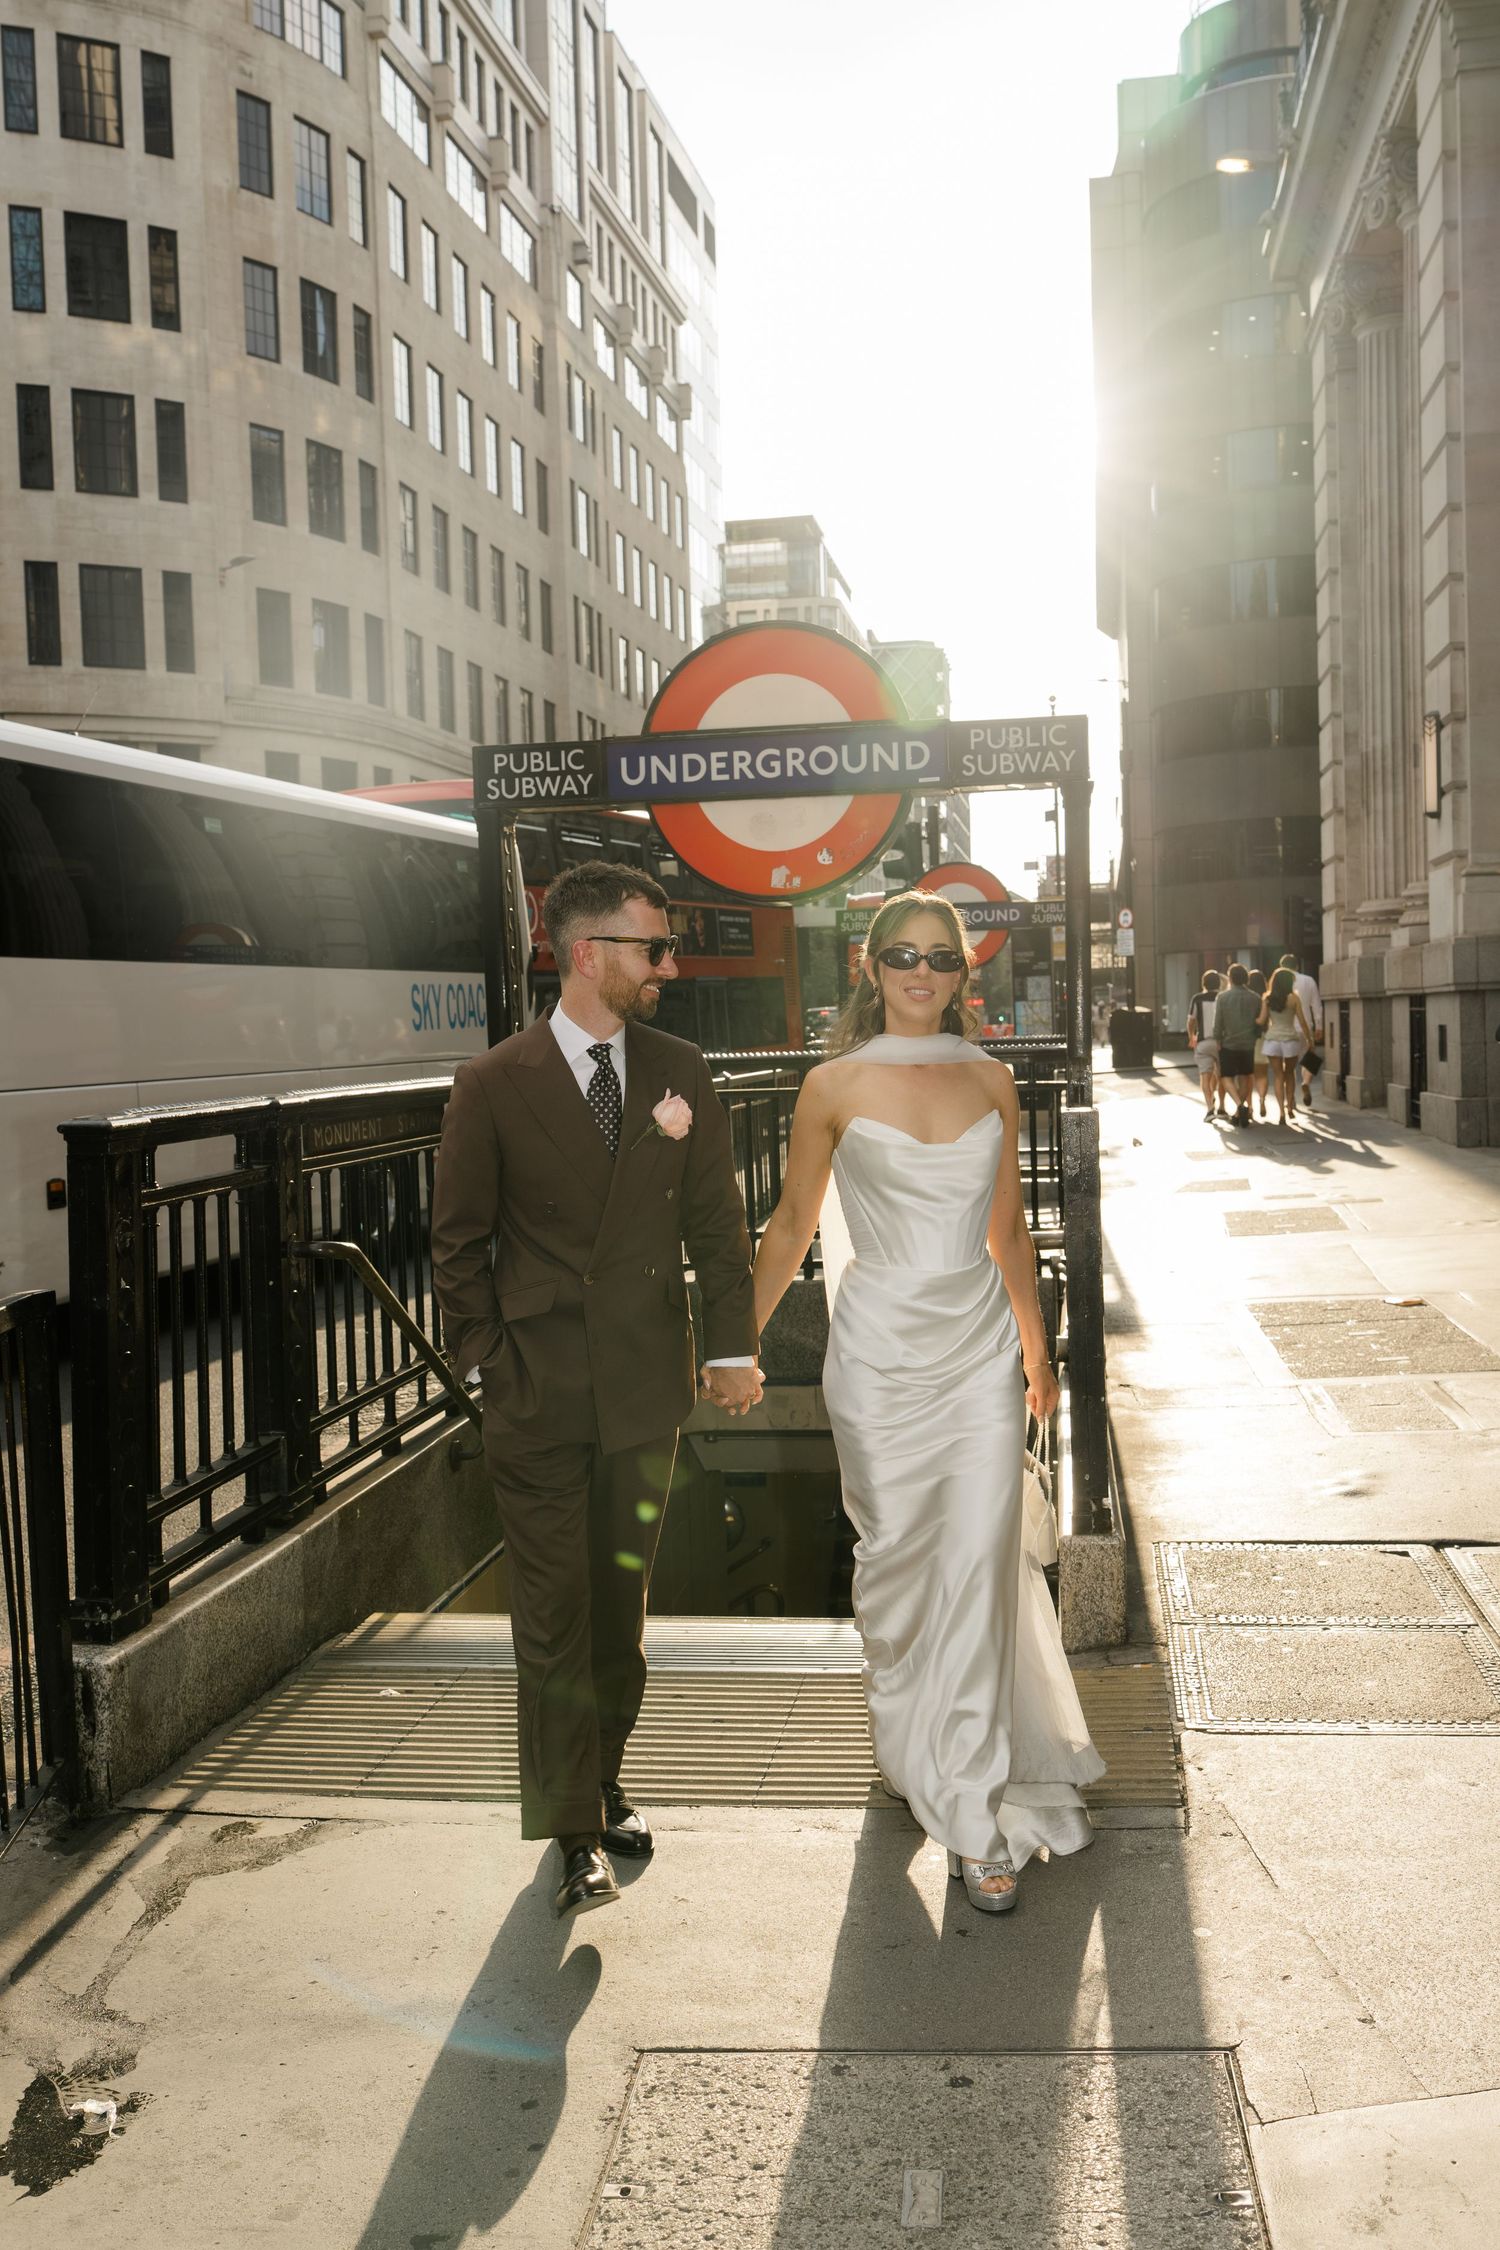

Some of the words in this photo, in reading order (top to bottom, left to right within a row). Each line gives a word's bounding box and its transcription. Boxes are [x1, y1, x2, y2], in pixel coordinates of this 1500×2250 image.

[970, 724, 1067, 750] PUBLIC
[493, 748, 585, 774] PUBLIC
[620, 740, 931, 786] UNDERGROUND
[961, 749, 1076, 776] SUBWAY
[486, 773, 593, 800] SUBWAY
[411, 983, 441, 1032] SKY
[313, 1117, 382, 1147] MONUMENT
